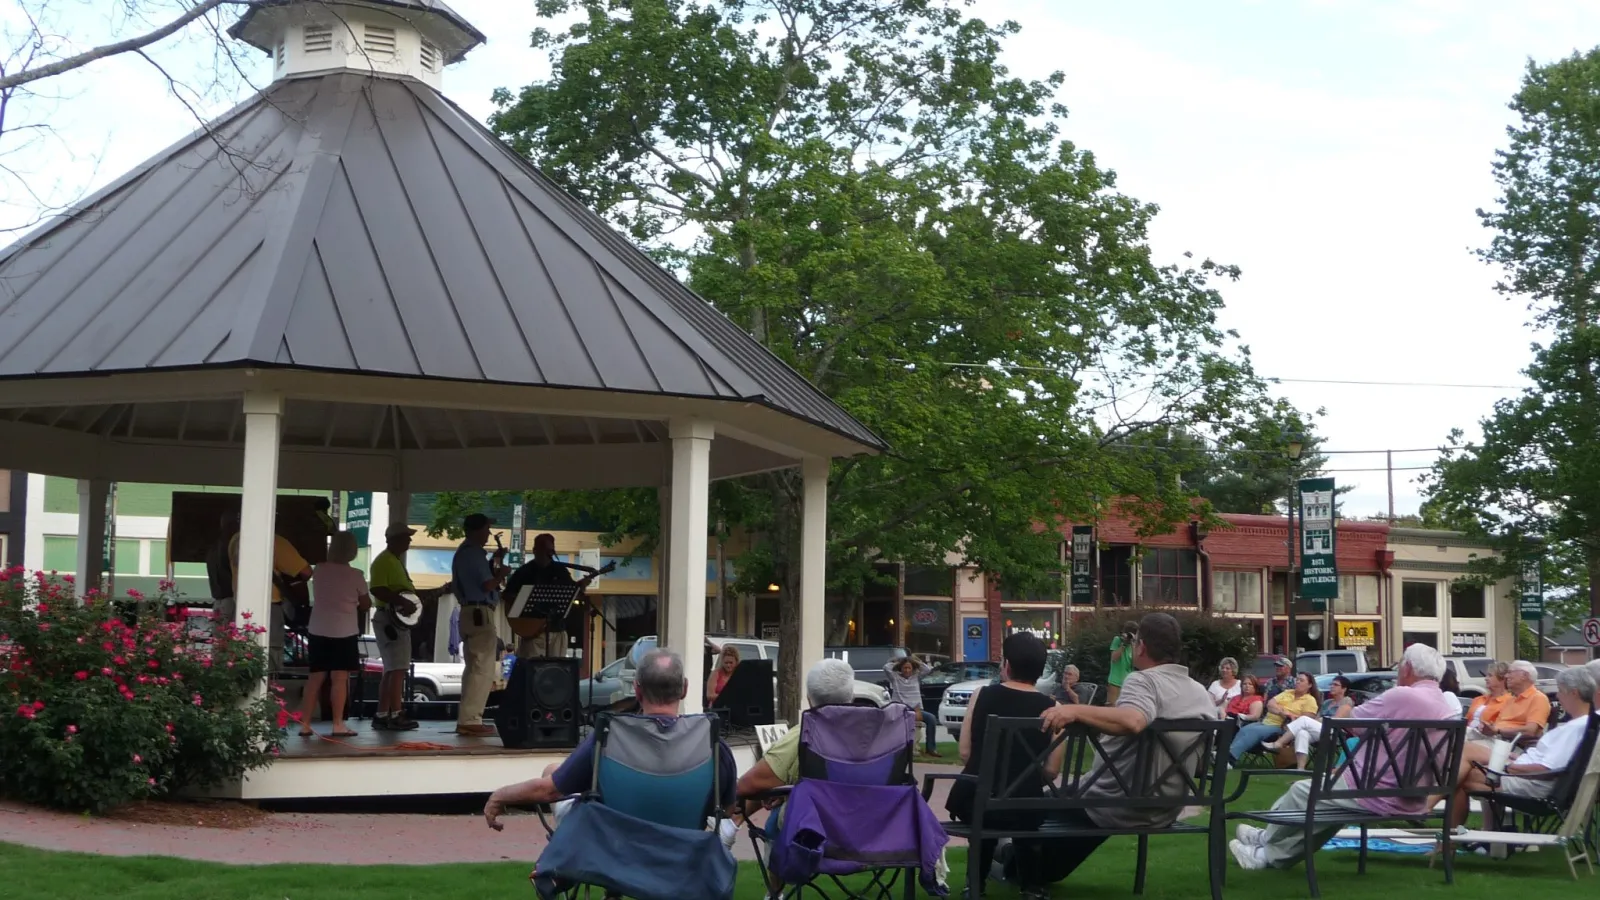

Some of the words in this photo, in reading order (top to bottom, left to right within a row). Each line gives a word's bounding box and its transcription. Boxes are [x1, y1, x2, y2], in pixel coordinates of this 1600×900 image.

[1304, 567, 1334, 575] HISTORIC
[1302, 576, 1337, 584] RUTLEDGE
[1344, 627, 1368, 637] LODGE
